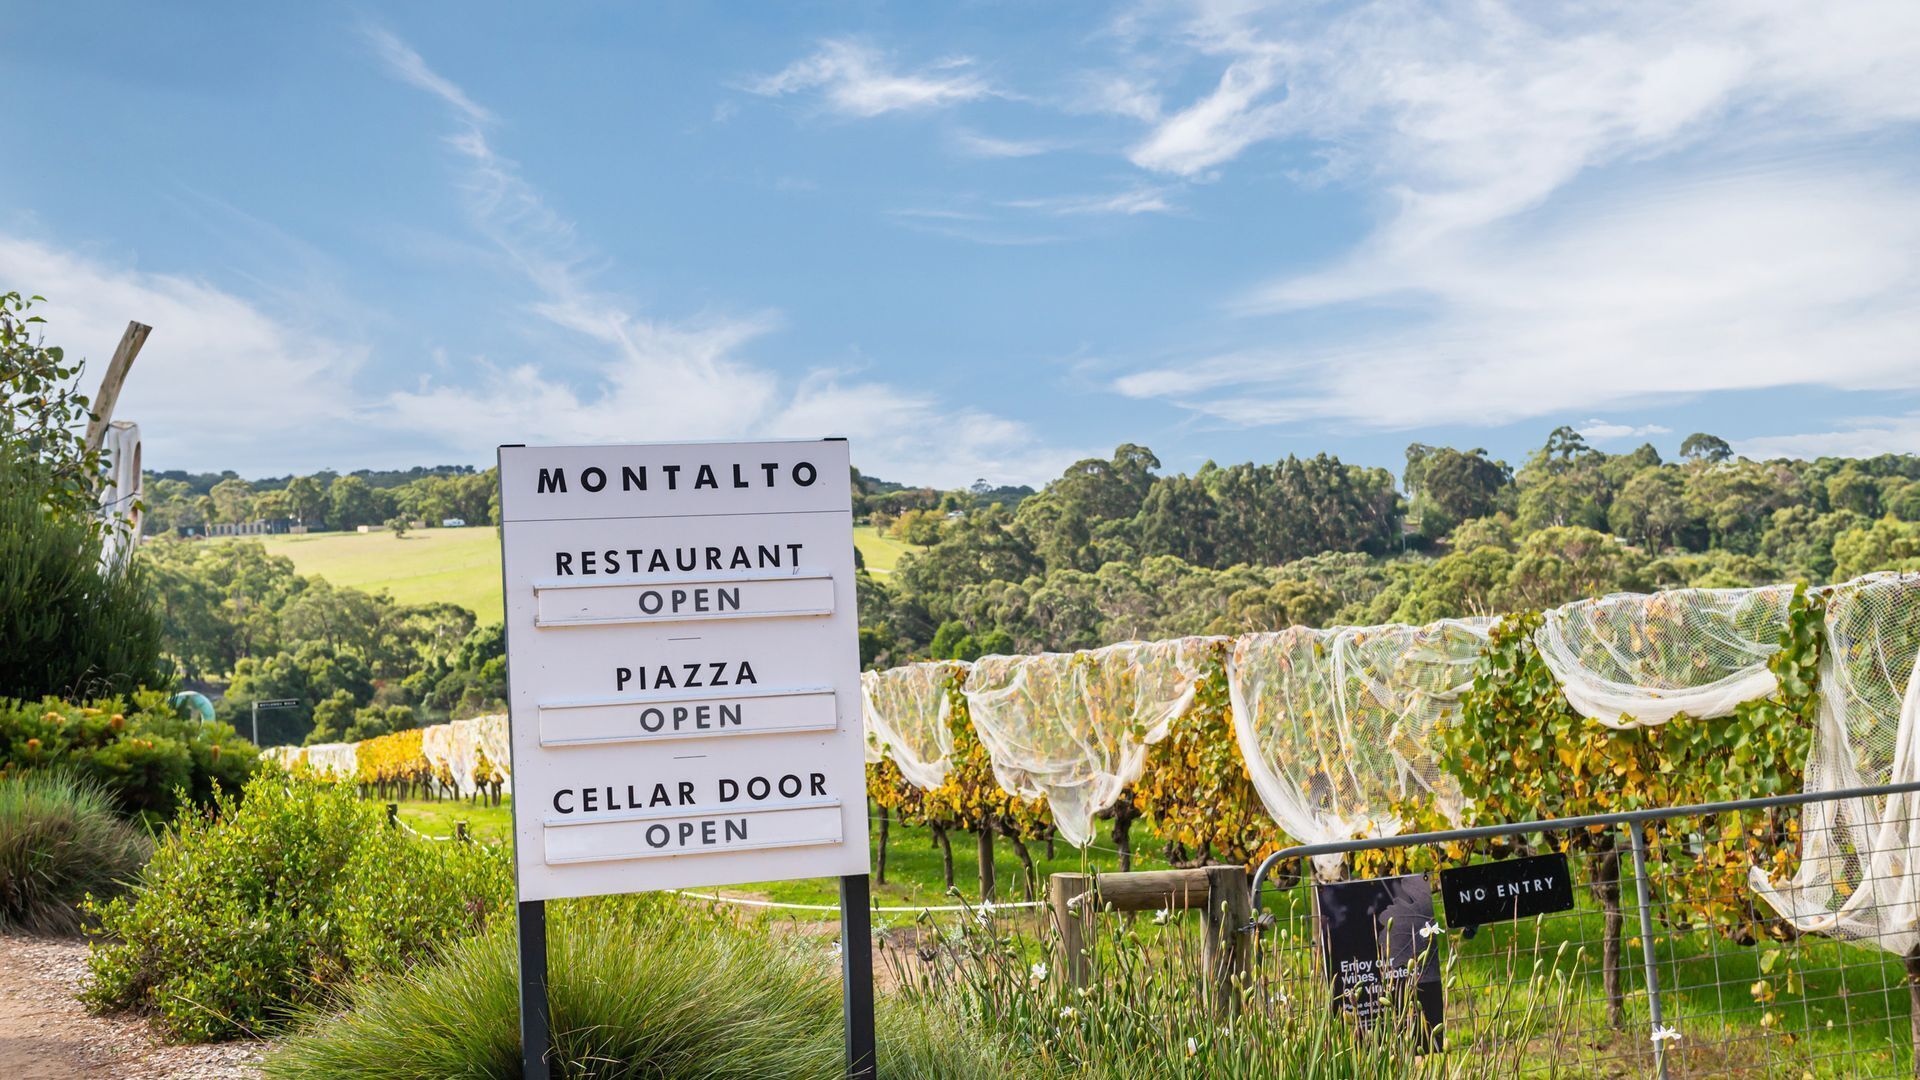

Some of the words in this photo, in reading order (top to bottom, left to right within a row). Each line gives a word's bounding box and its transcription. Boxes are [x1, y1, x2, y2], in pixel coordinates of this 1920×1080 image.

[537, 461, 818, 494] MONTALTO
[555, 543, 803, 576] RESTAURANT
[638, 587, 741, 615] OPEN
[616, 661, 758, 692] PIAZZA
[639, 703, 742, 733] OPEN
[553, 781, 696, 815] CELLAR
[718, 772, 827, 803] DOOR
[645, 818, 748, 849] OPEN
[1459, 888, 1486, 903] NO
[1497, 877, 1553, 897] ENTRY
[1340, 959, 1372, 973] Enjoy
[1375, 957, 1395, 968] or
